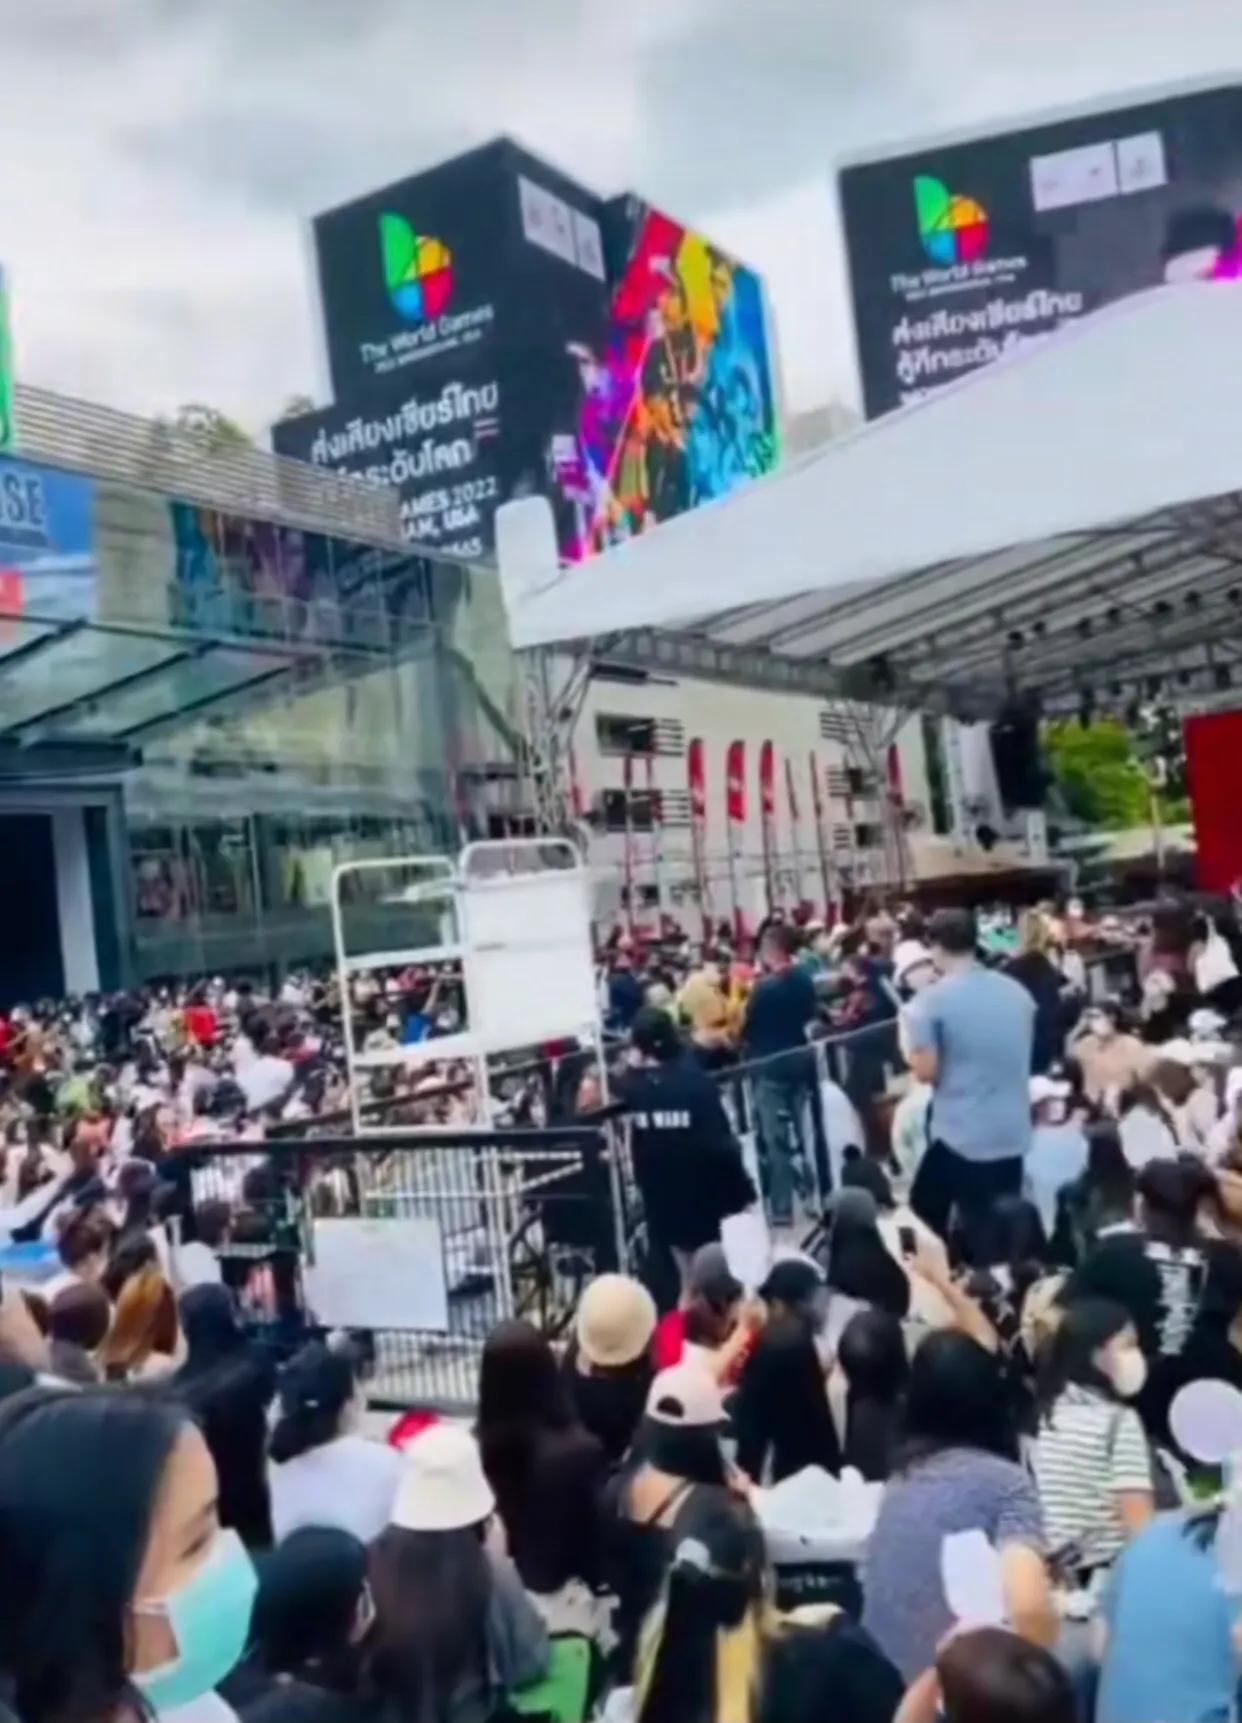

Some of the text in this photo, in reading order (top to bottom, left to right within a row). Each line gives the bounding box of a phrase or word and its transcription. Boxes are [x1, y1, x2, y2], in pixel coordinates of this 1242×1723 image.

[891, 275, 919, 293] The
[923, 264, 969, 286] World
[973, 256, 1027, 276] Games
[361, 342, 387, 363] The
[391, 323, 436, 349] World
[440, 305, 494, 335] Games
[0, 474, 44, 526] SE
